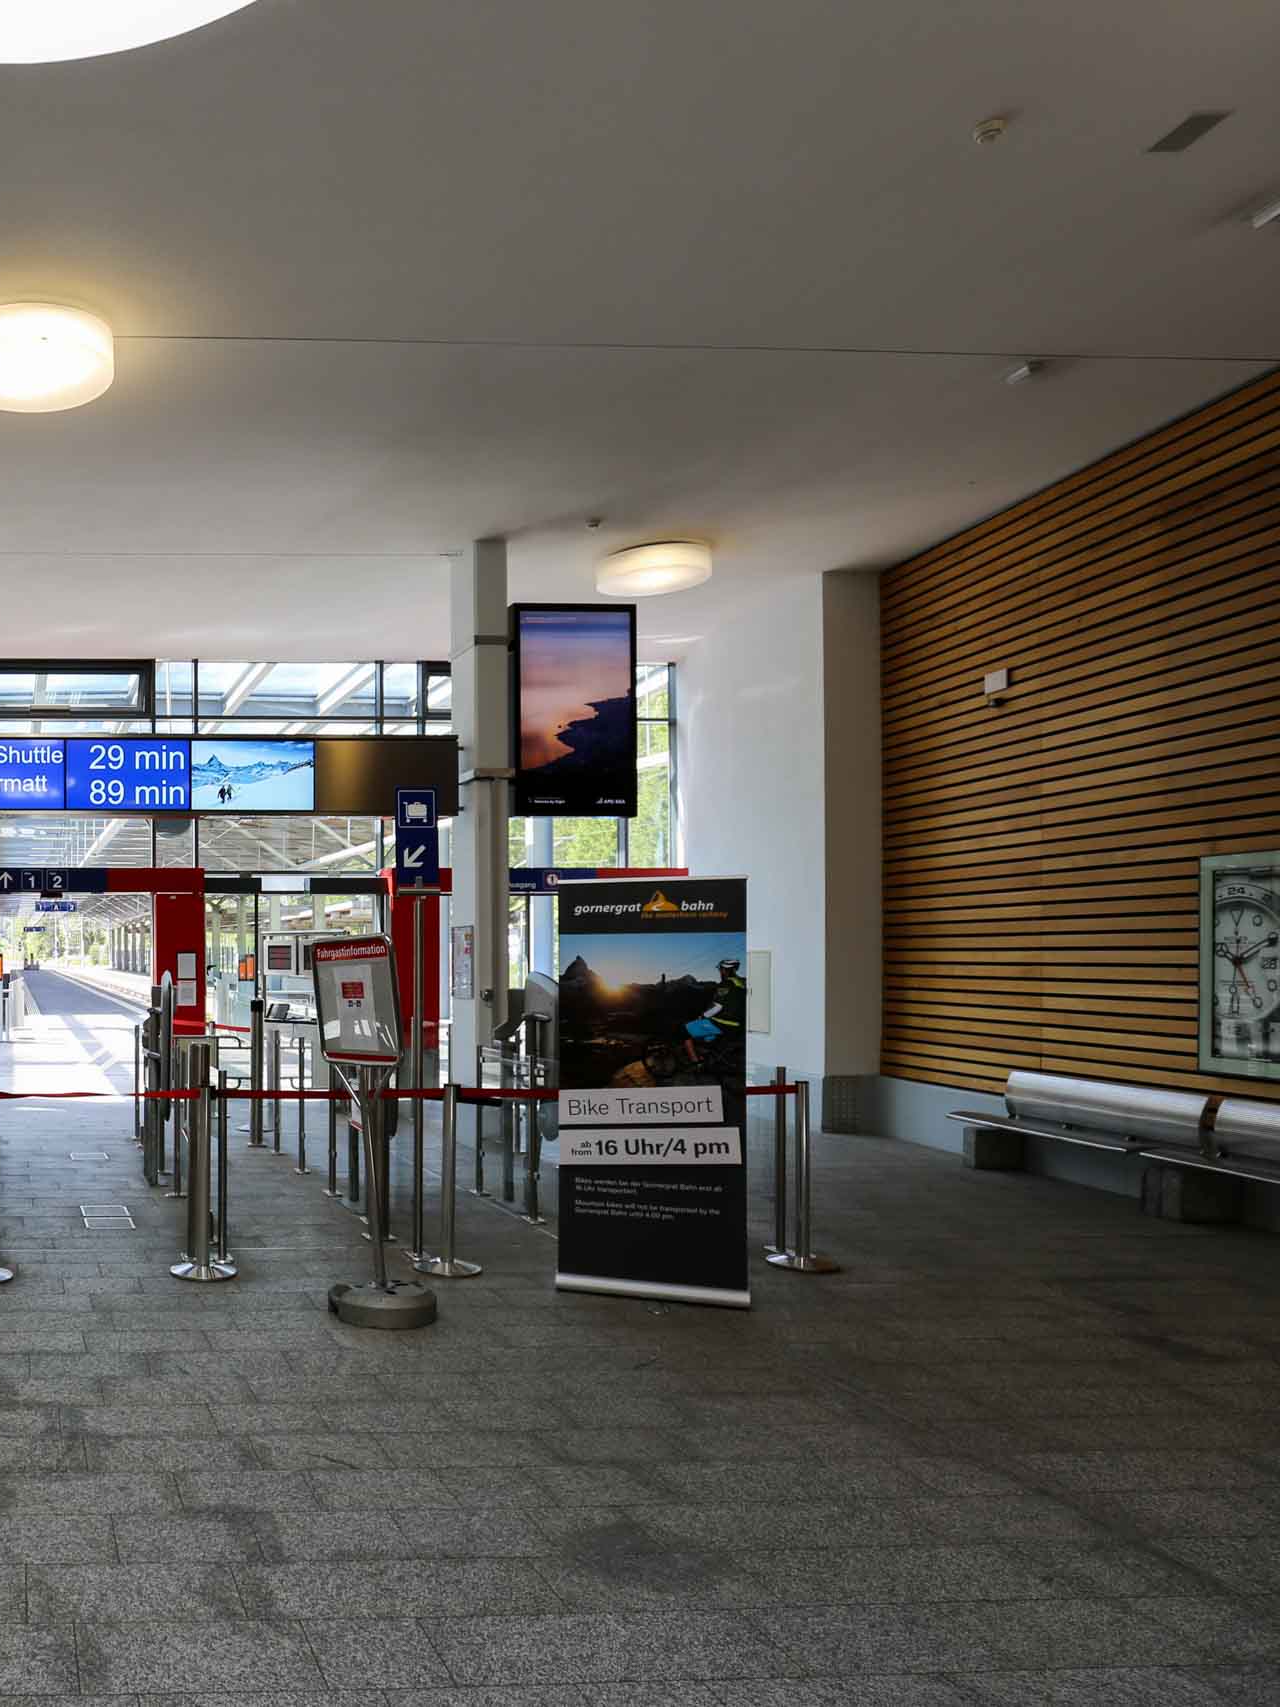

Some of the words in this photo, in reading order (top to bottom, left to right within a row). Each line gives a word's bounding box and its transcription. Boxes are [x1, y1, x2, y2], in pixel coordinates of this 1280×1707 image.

[89, 745, 125, 770] 29
[135, 745, 185, 769] min
[89, 779, 125, 805] 89
[135, 780, 185, 805] min
[29, 875, 35, 889] 1
[53, 876, 62, 888] 2
[574, 902, 641, 916] gornergrat
[681, 900, 714, 911] bahn
[316, 944, 386, 961] Fahrgastinformation
[568, 1099, 609, 1116] Bike
[616, 1097, 713, 1117] Transport
[571, 1148, 592, 1156] from
[595, 1139, 618, 1156] 16
[625, 1138, 687, 1158] Uhr/4
[694, 1141, 730, 1158] pm
[580, 1141, 592, 1149] ab
